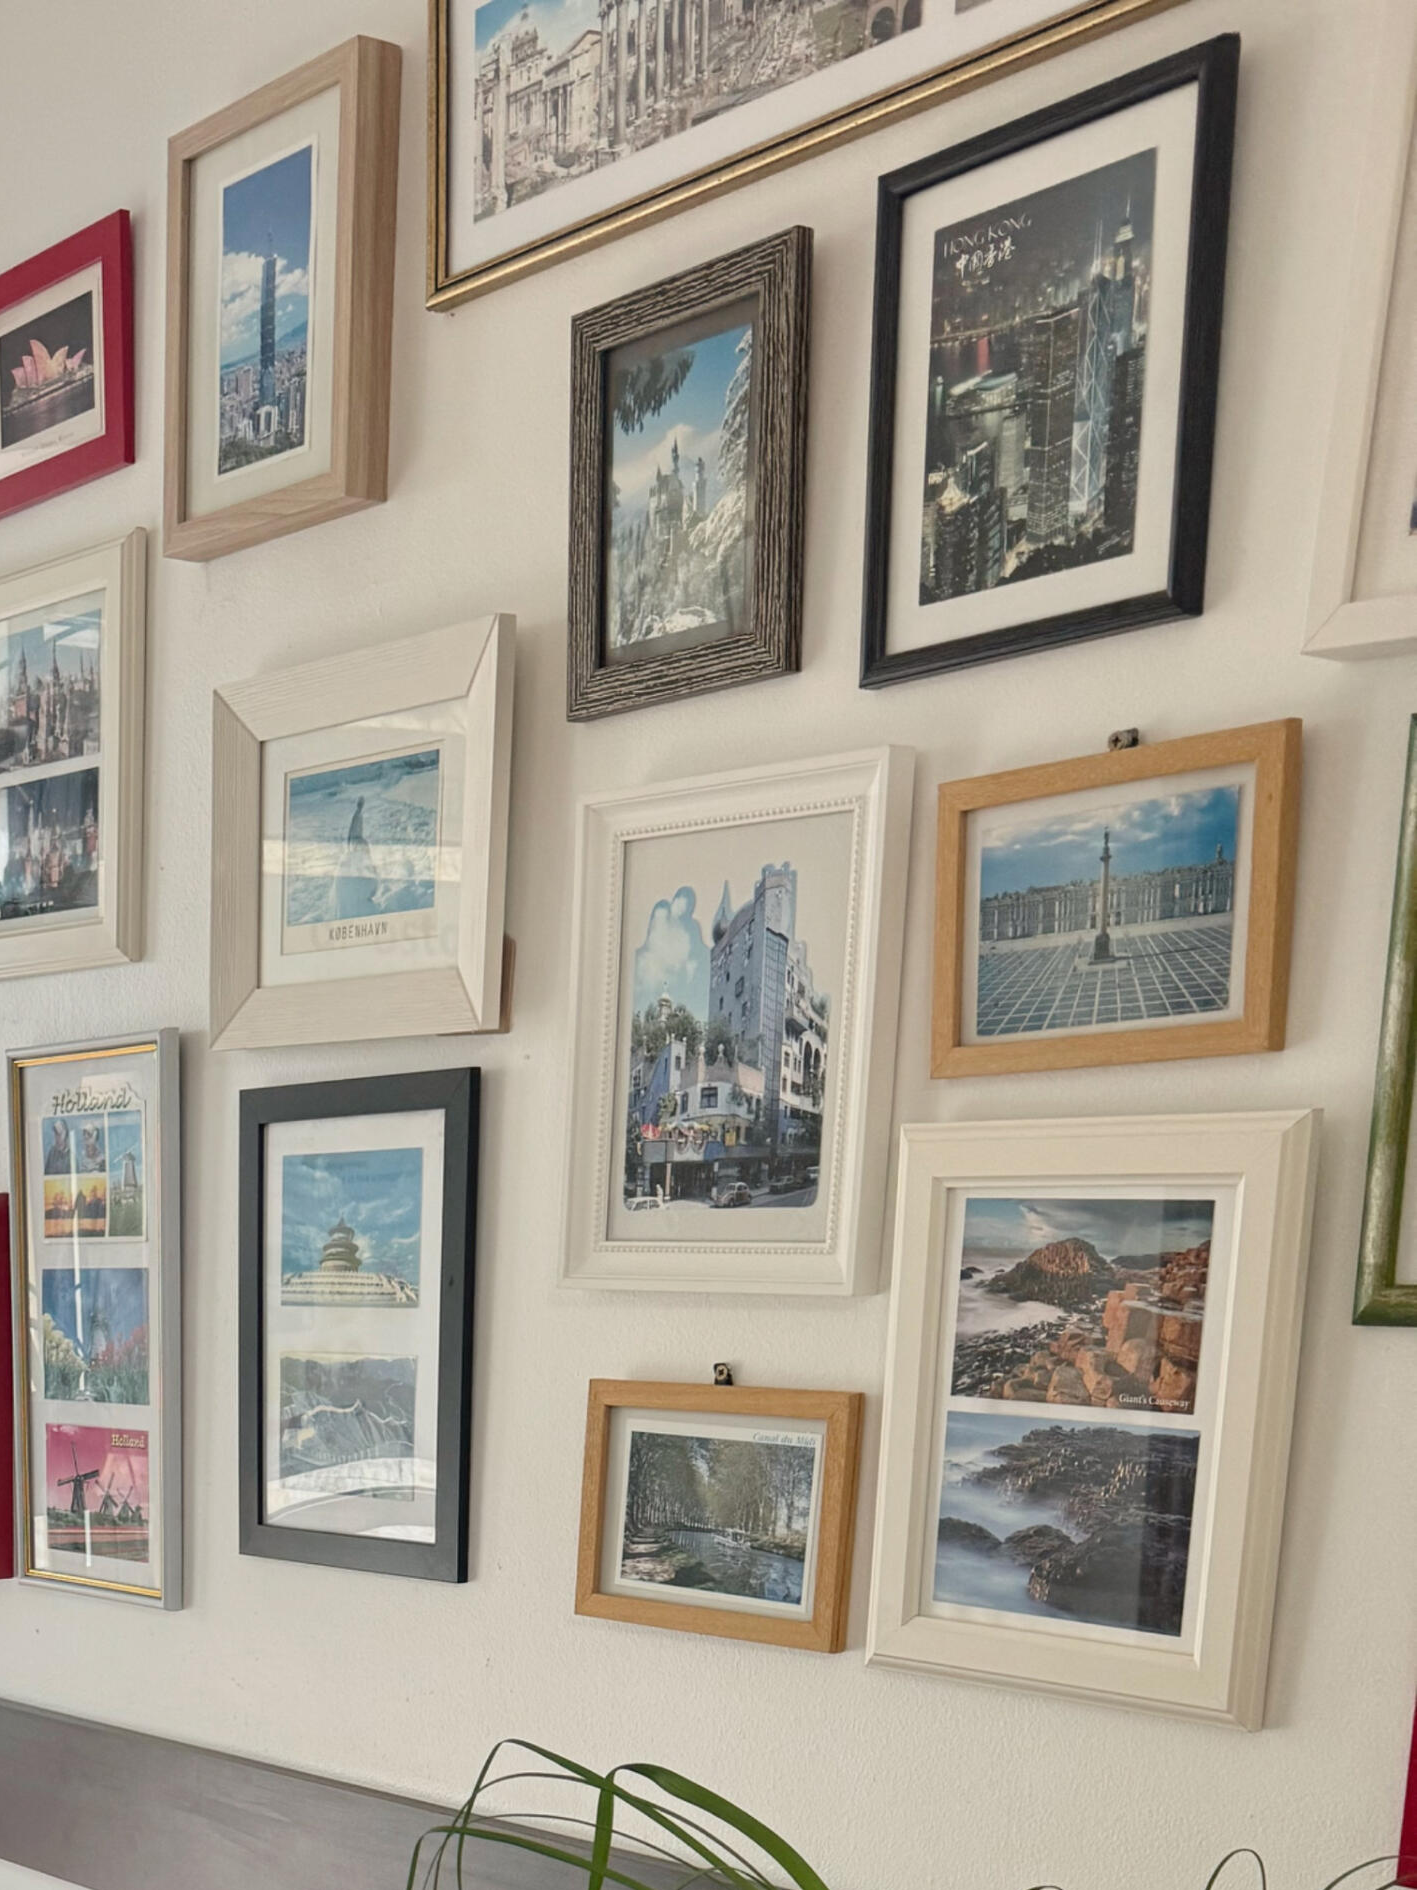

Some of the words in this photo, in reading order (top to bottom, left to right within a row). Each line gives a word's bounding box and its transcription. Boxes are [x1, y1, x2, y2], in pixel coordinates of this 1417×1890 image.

[943, 230, 985, 259] HONG
[987, 212, 1032, 242] KONG
[52, 1086, 132, 1116] Holland
[111, 1434, 145, 1448] Holland
